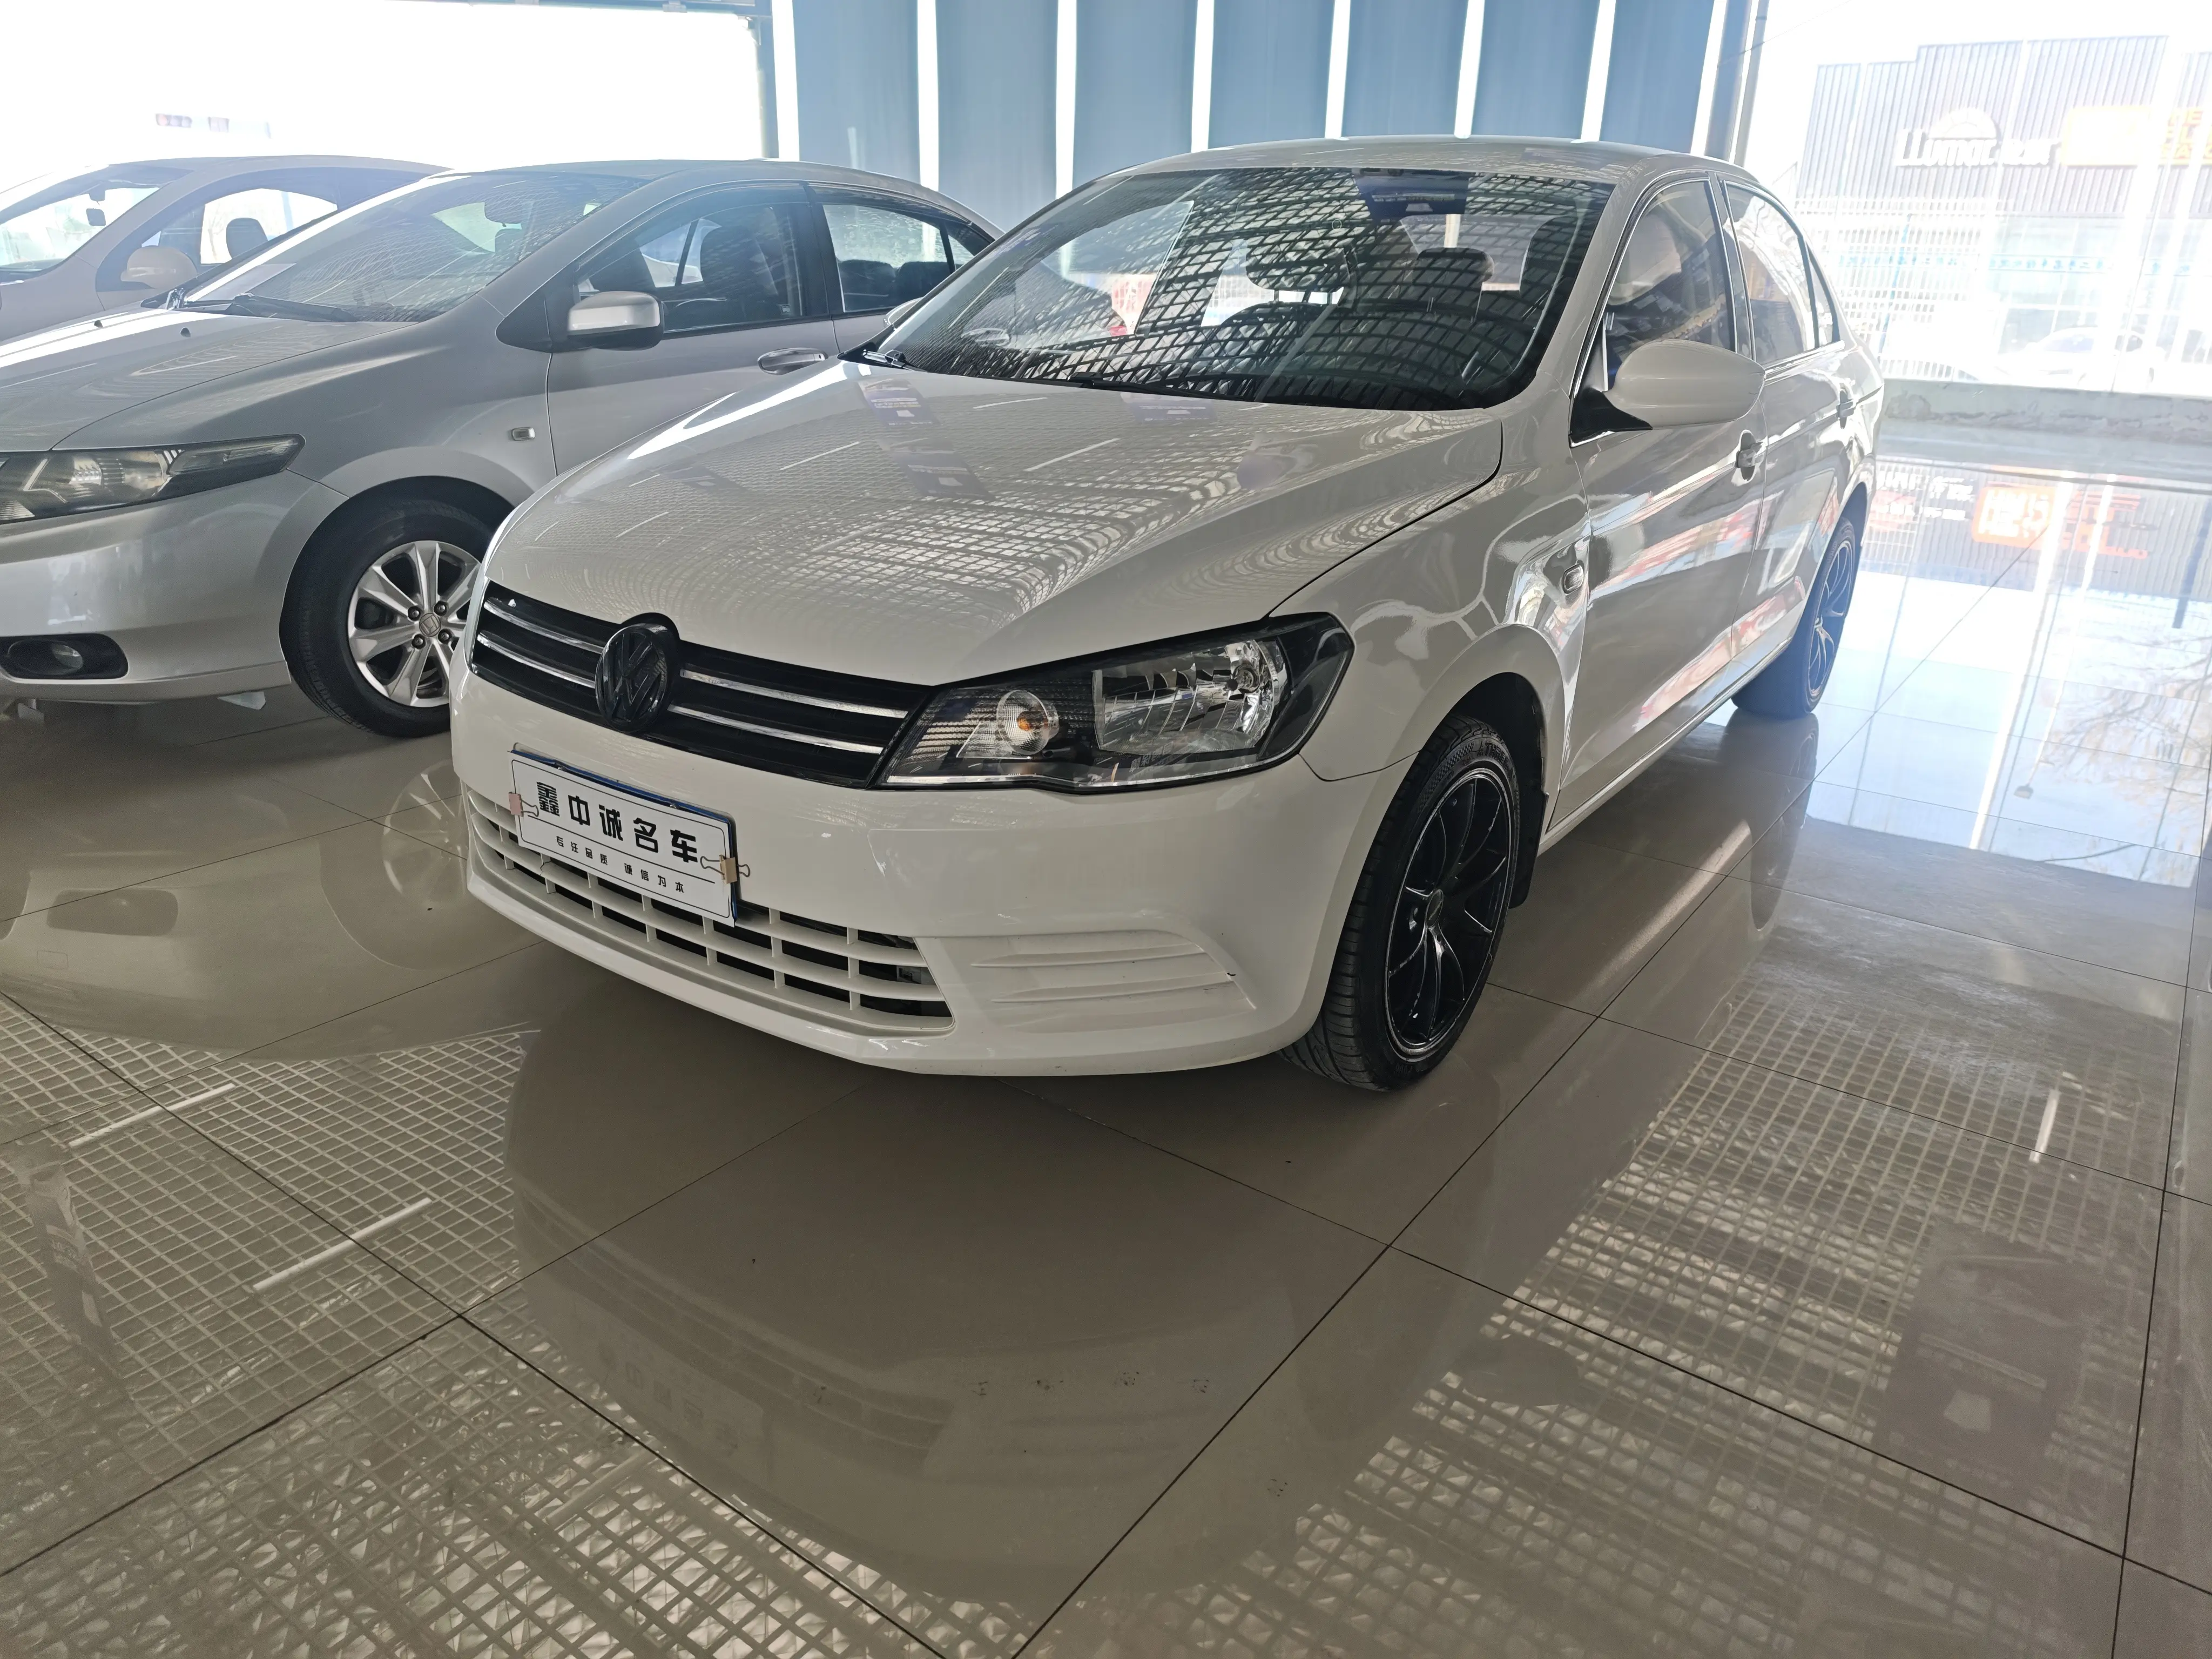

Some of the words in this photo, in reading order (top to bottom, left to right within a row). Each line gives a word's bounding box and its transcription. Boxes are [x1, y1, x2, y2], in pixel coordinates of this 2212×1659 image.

[537, 783, 698, 862] 鑫中诚名车
[556, 837, 608, 865] 专注品质
[624, 864, 684, 893] 诚信为本
